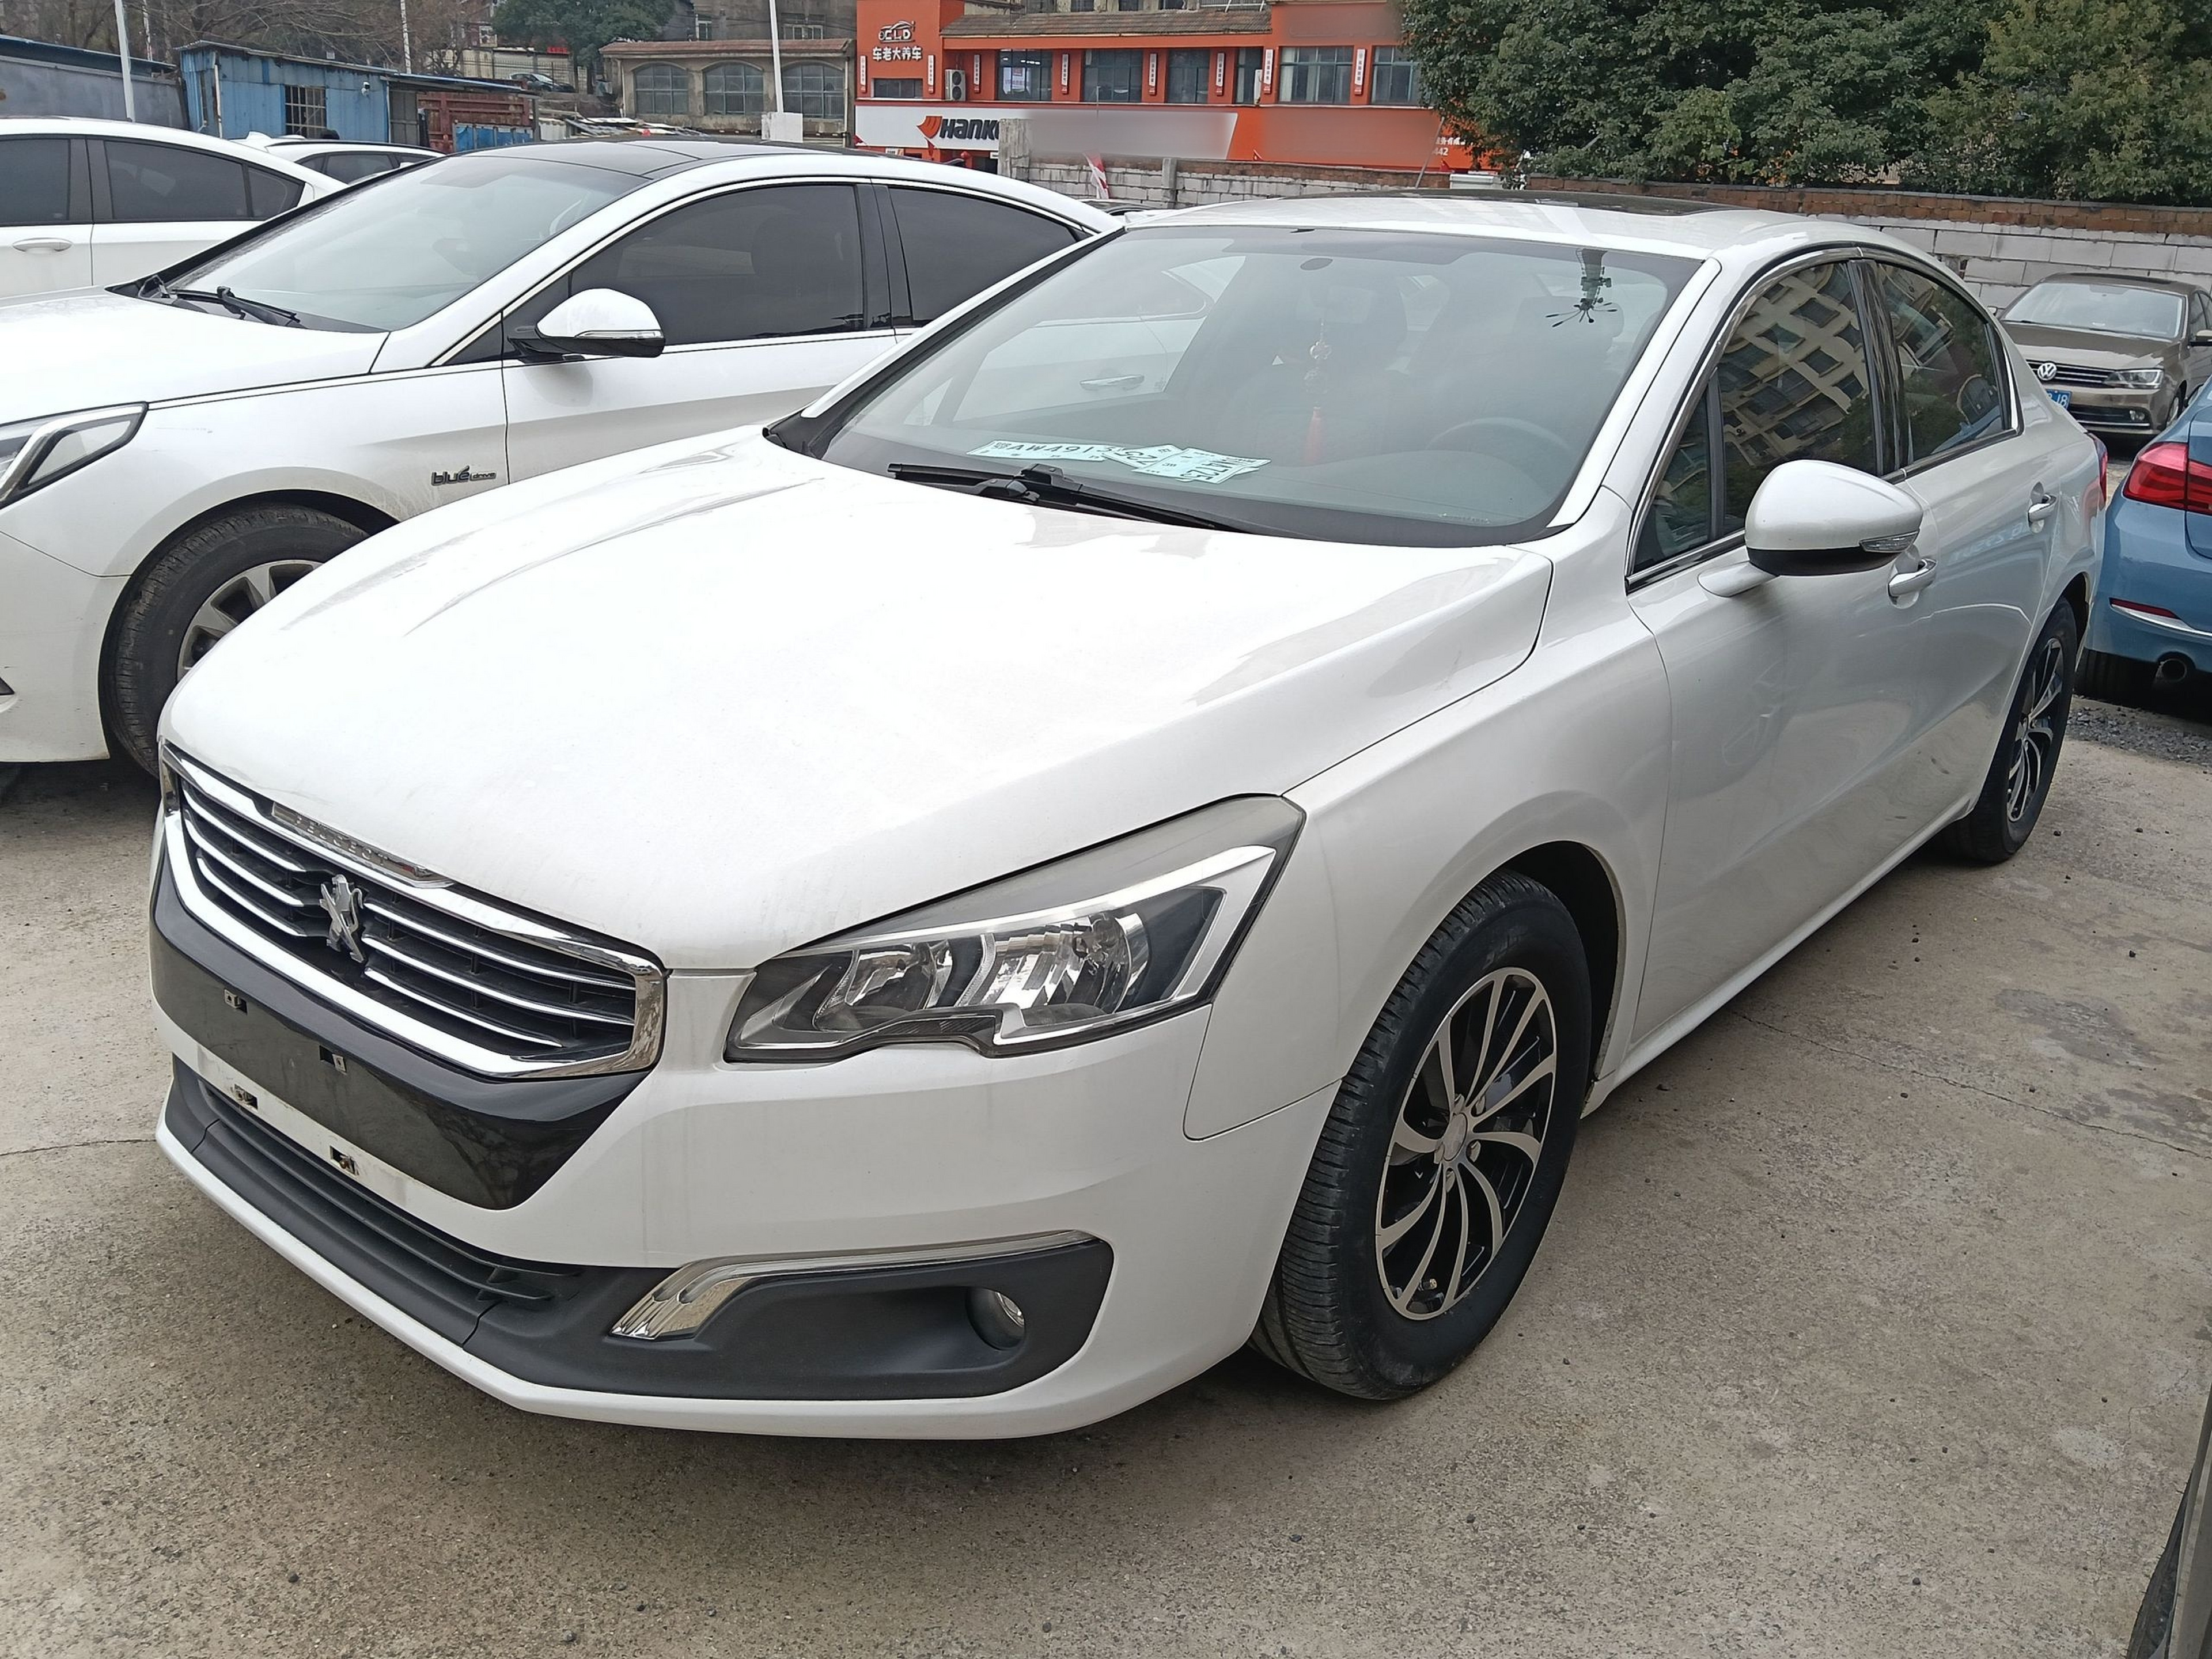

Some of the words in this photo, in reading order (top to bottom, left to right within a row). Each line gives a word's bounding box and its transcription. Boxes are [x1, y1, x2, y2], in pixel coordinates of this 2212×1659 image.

[872, 46, 922, 61] 车老大养车
